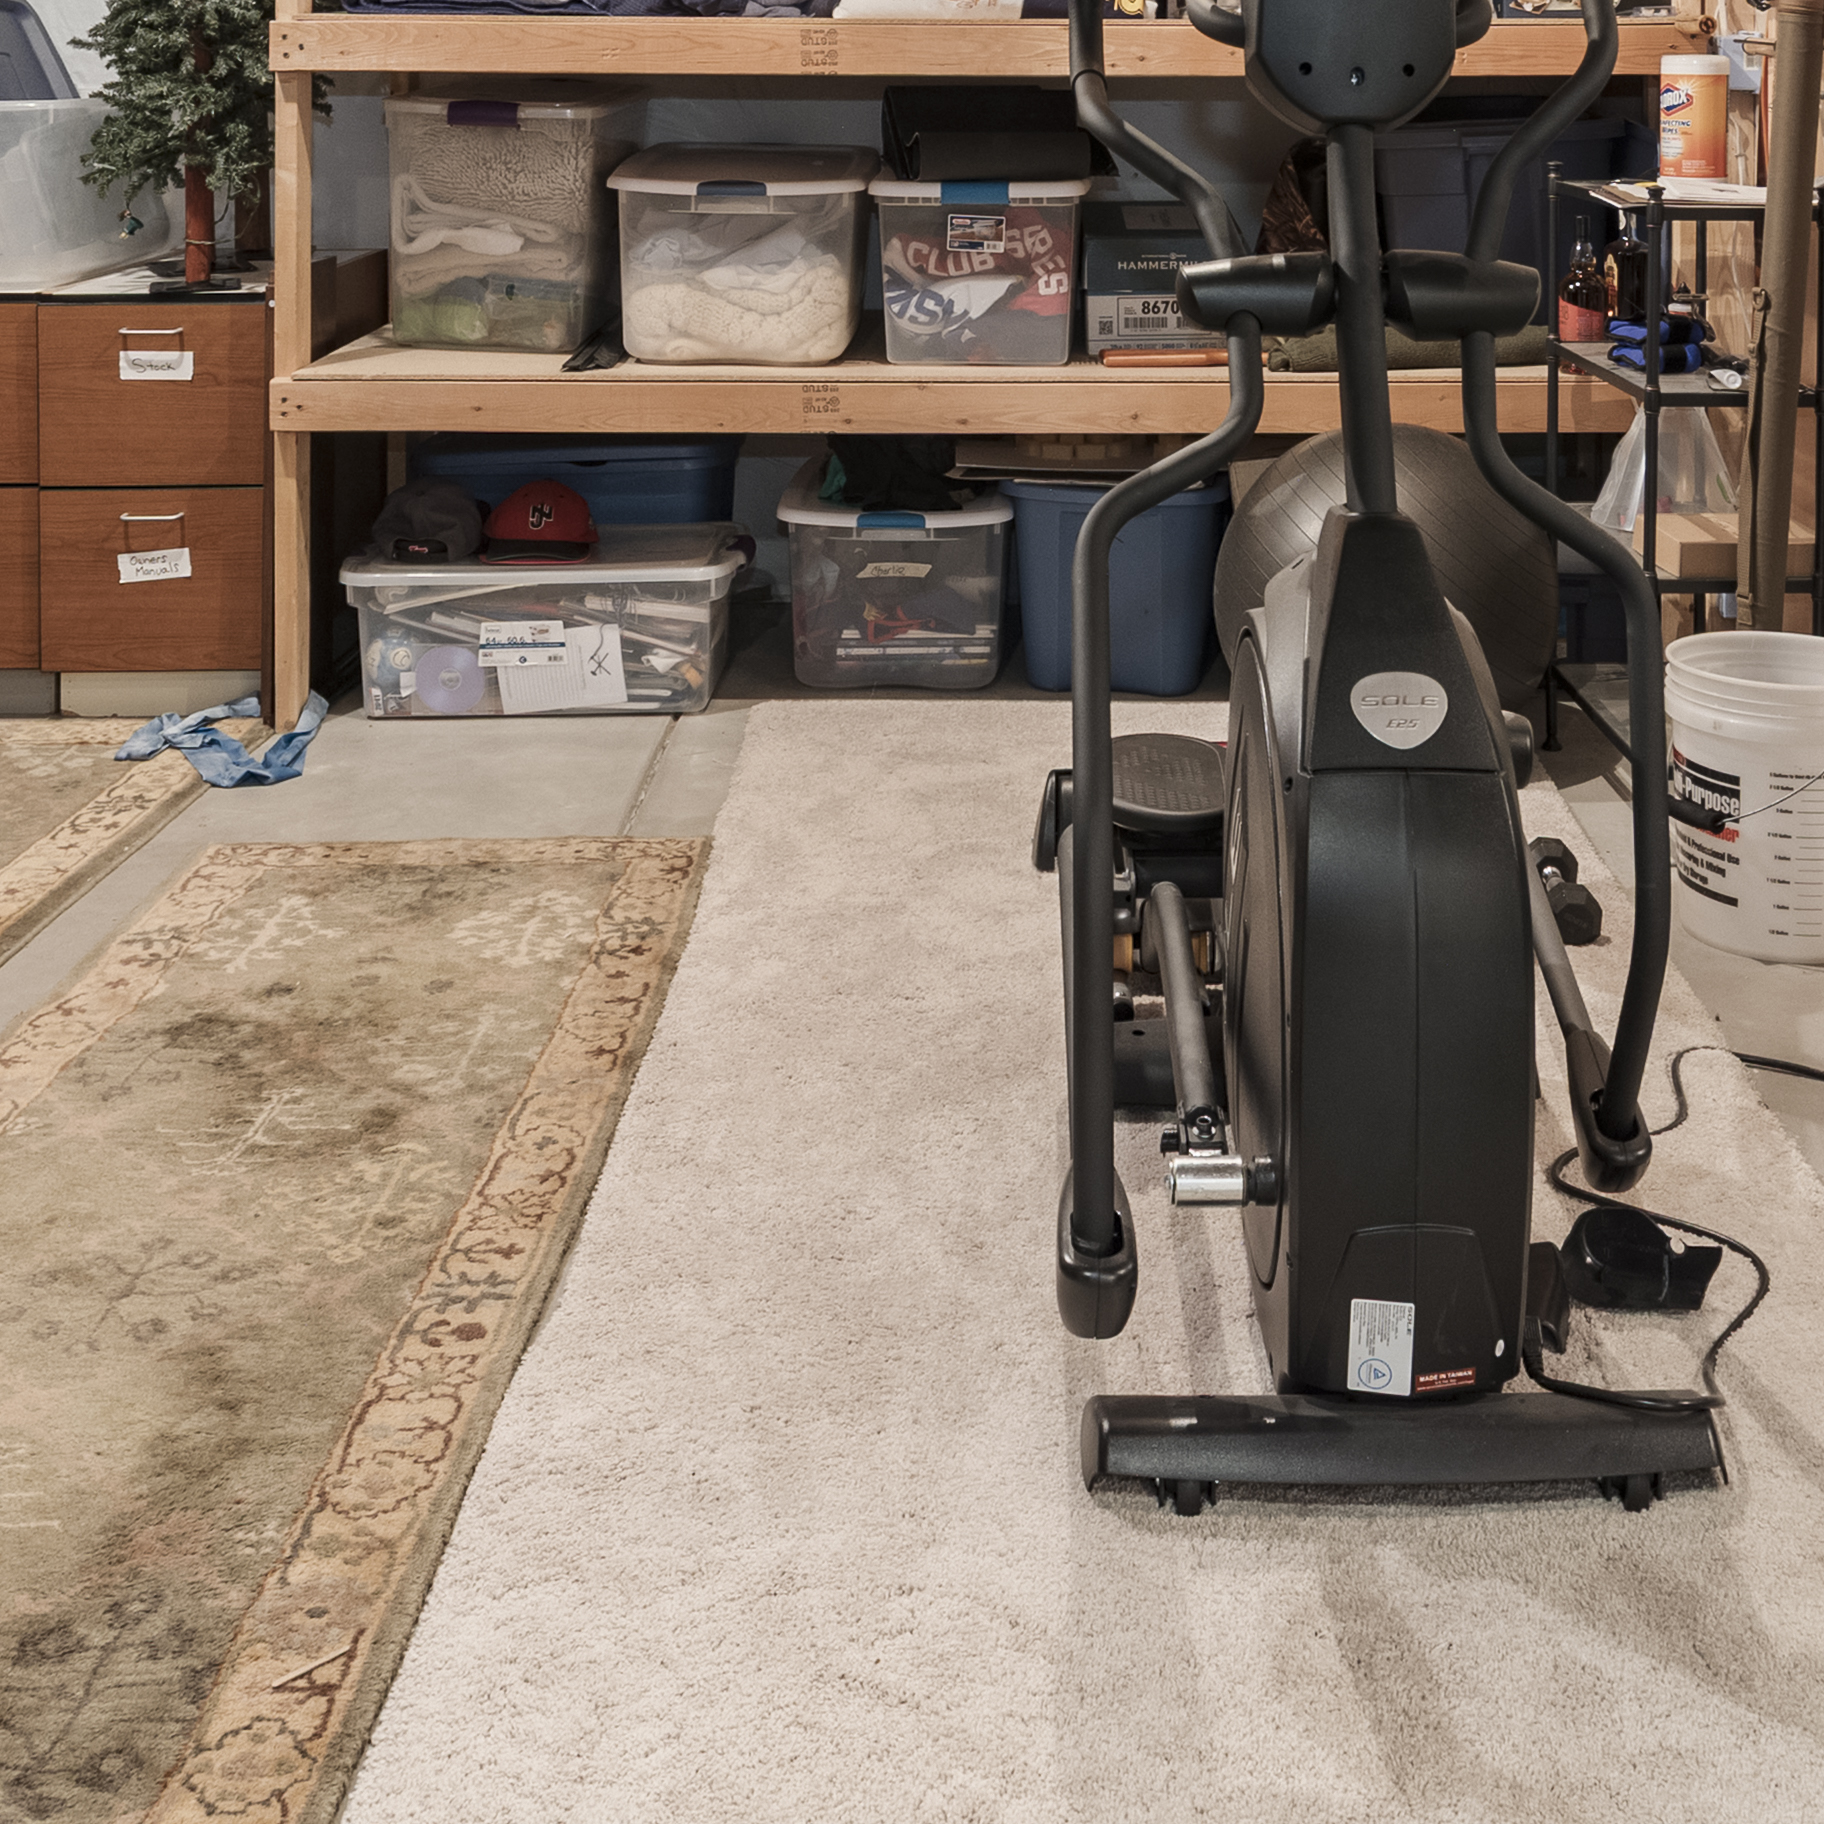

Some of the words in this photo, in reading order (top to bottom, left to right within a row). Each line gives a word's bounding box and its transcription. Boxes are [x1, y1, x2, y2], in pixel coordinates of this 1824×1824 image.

[906, 240, 996, 277] CLUB
[1140, 300, 1180, 315] 8670
[131, 357, 176, 374] Stock
[129, 554, 168, 567] Owners
[135, 562, 180, 578] Manuals
[870, 565, 906, 576] Charlie
[1360, 694, 1440, 710] SOLE
[1418, 1373, 1438, 1383] MADE
[1447, 1370, 1473, 1379] TAIWAN
